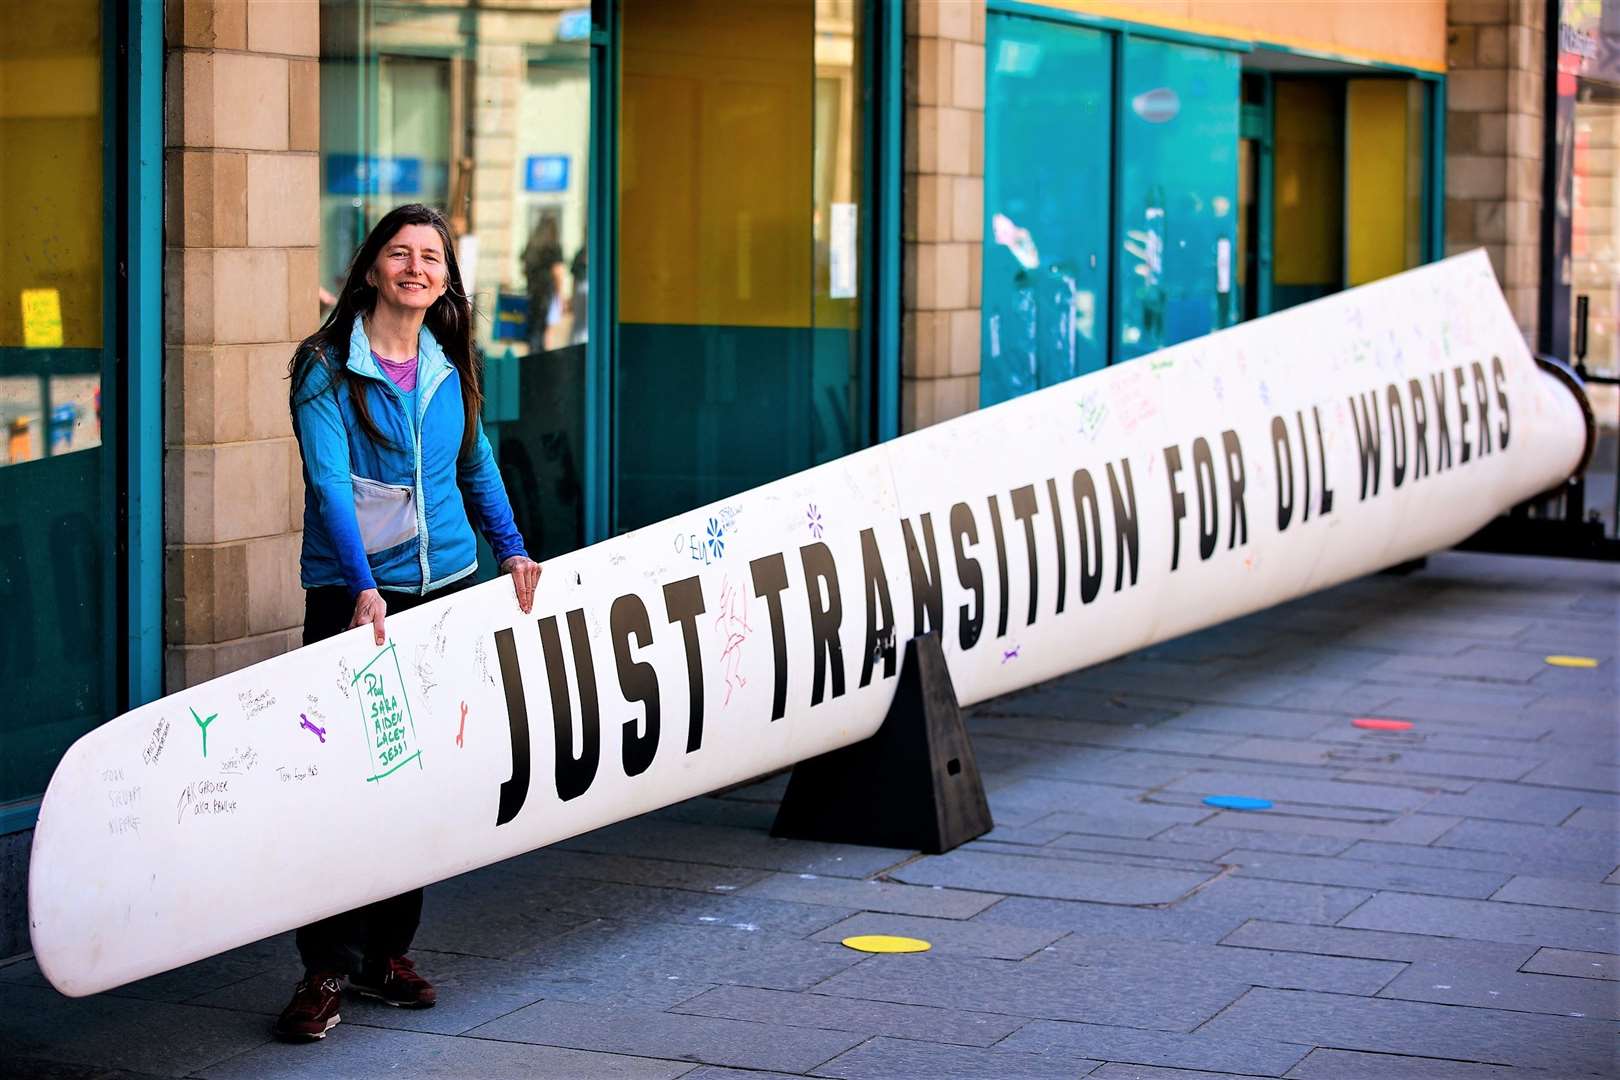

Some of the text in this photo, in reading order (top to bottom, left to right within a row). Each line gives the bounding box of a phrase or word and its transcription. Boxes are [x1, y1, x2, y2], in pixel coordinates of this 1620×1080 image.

[494, 575, 706, 826] JUST
[749, 457, 1139, 721] TRANSITION
[1163, 429, 1248, 572] FOR
[1271, 406, 1333, 532] OIL
[1349, 356, 1511, 502] WORKERS
[371, 696, 398, 719] SARA
[375, 709, 403, 734] AIDEN
[376, 726, 406, 748] LACEY
